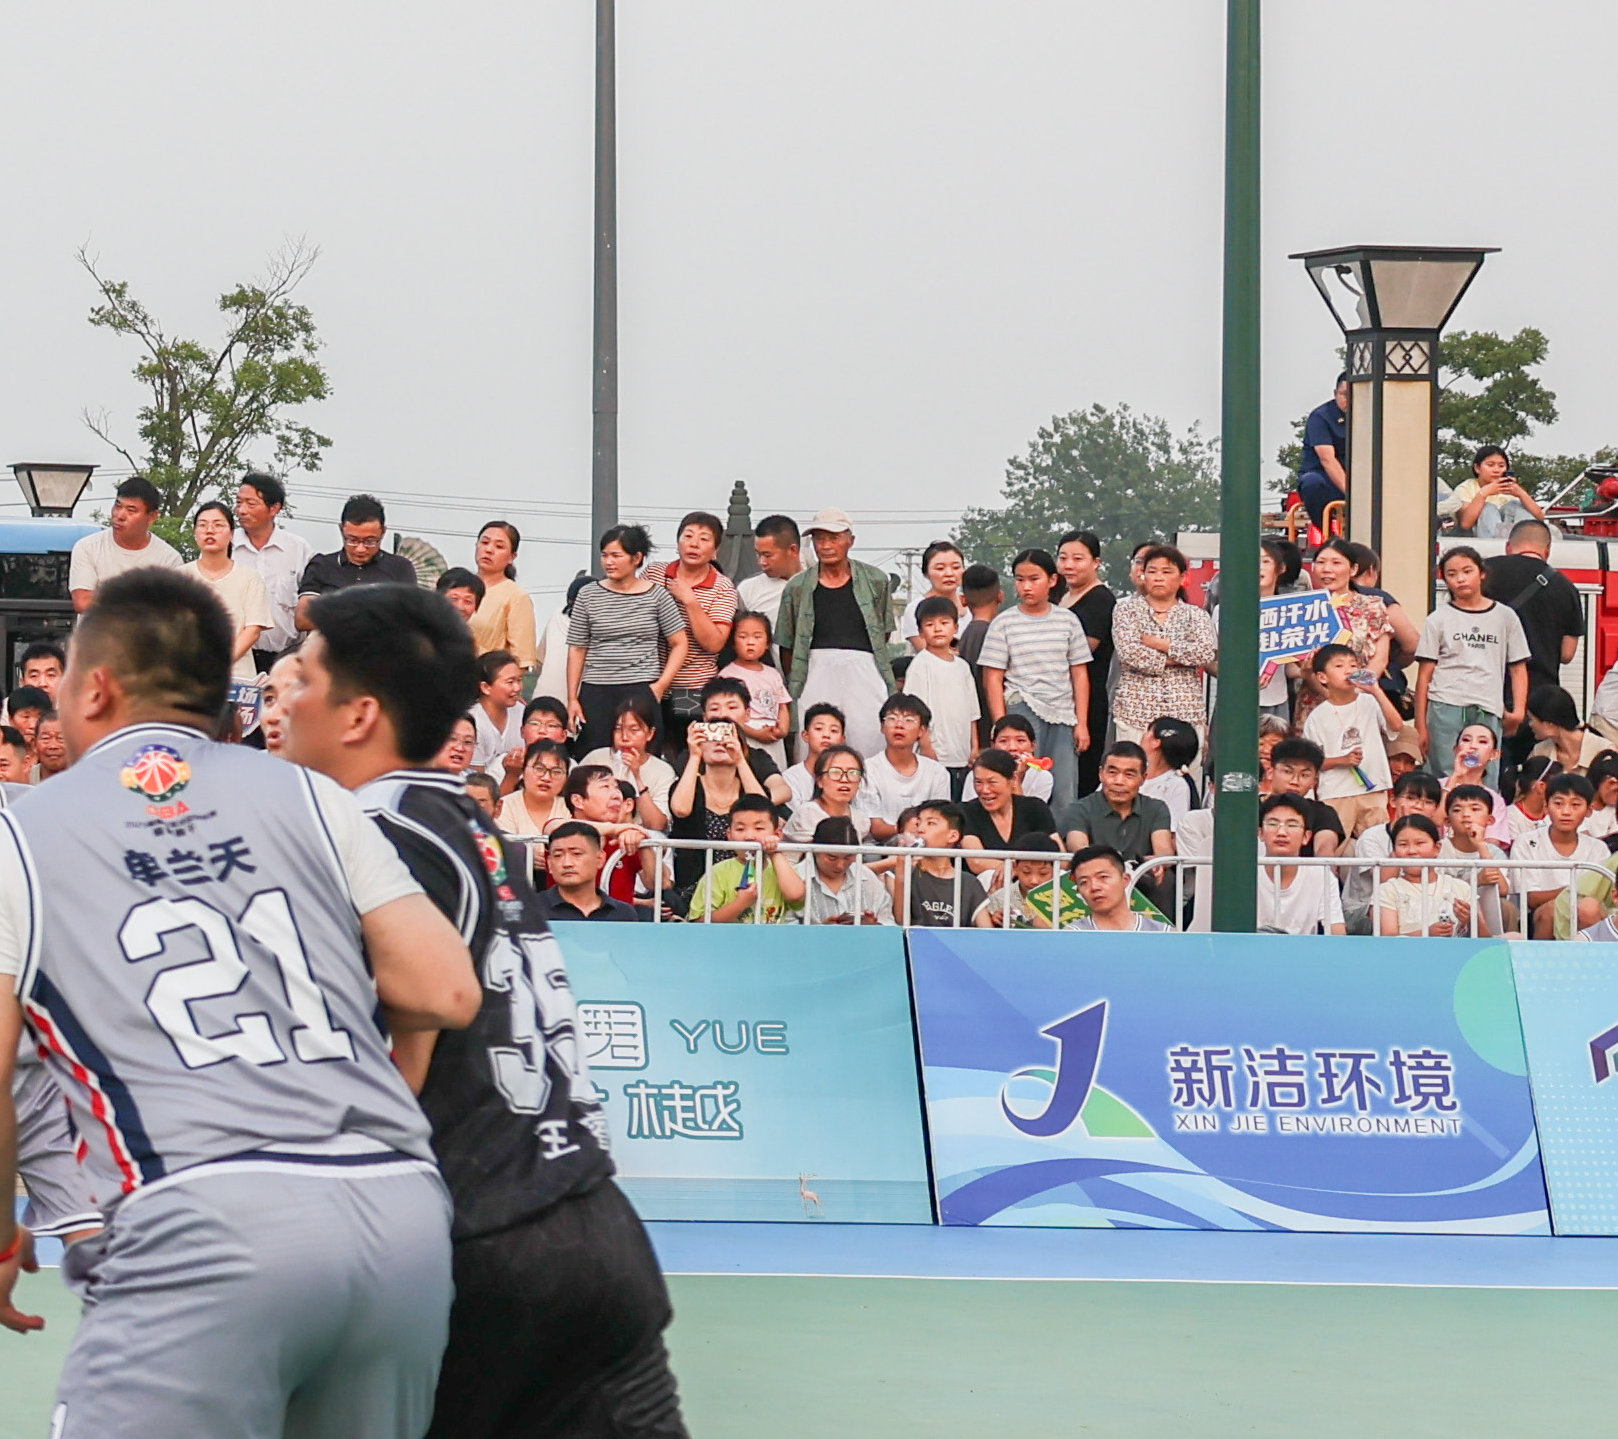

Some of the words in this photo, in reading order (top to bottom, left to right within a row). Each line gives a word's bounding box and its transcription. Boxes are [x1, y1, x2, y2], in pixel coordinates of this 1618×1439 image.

[1453, 632, 1499, 644] CHANEL
[118, 886, 357, 1069] 21
[671, 1020, 788, 1054] YUE
[1169, 1046, 1457, 1112] 新洁环境
[595, 1080, 744, 1141] 樾
[1176, 1114, 1217, 1130] XIN
[1230, 1115, 1267, 1131] JIE
[1280, 1116, 1461, 1134] ENVIRONMENT
